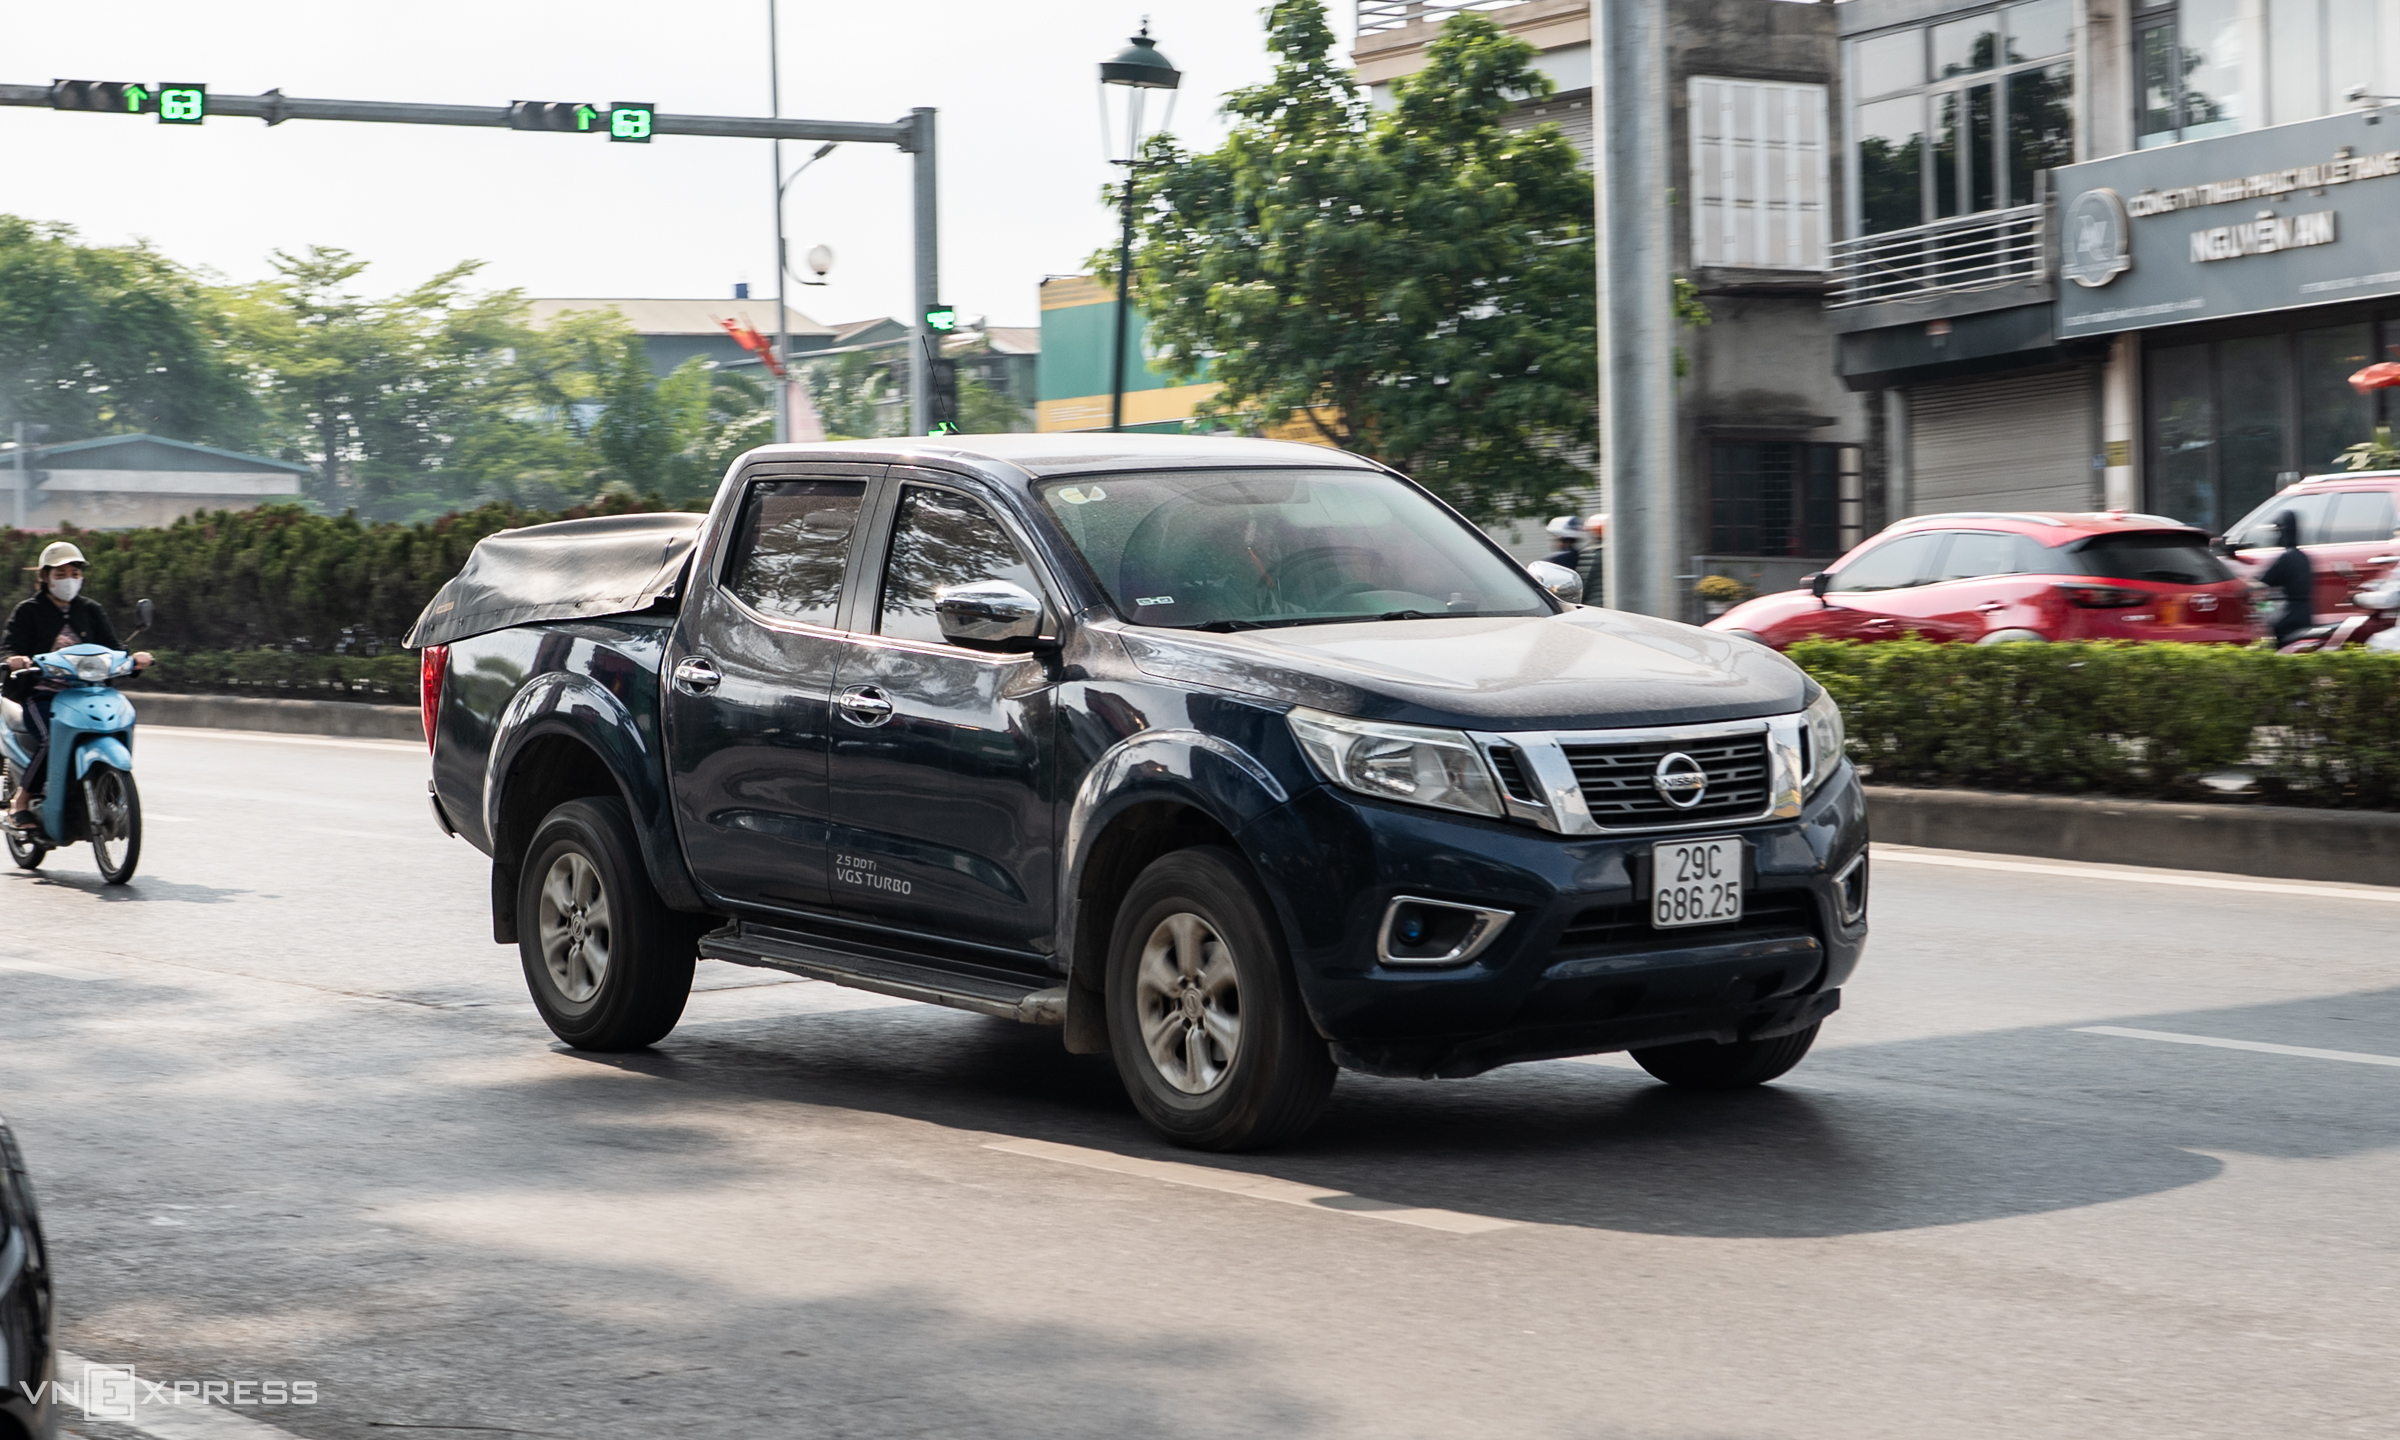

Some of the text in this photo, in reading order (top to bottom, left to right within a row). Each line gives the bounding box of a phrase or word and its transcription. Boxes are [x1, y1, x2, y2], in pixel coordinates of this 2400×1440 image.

[161, 89, 202, 120] 63
[611, 108, 651, 138] 63
[1662, 775, 1706, 788] NISSAN
[1676, 844, 1722, 882] 29C
[836, 867, 912, 895] VGS TURBO
[1657, 881, 1739, 923] 686.25
